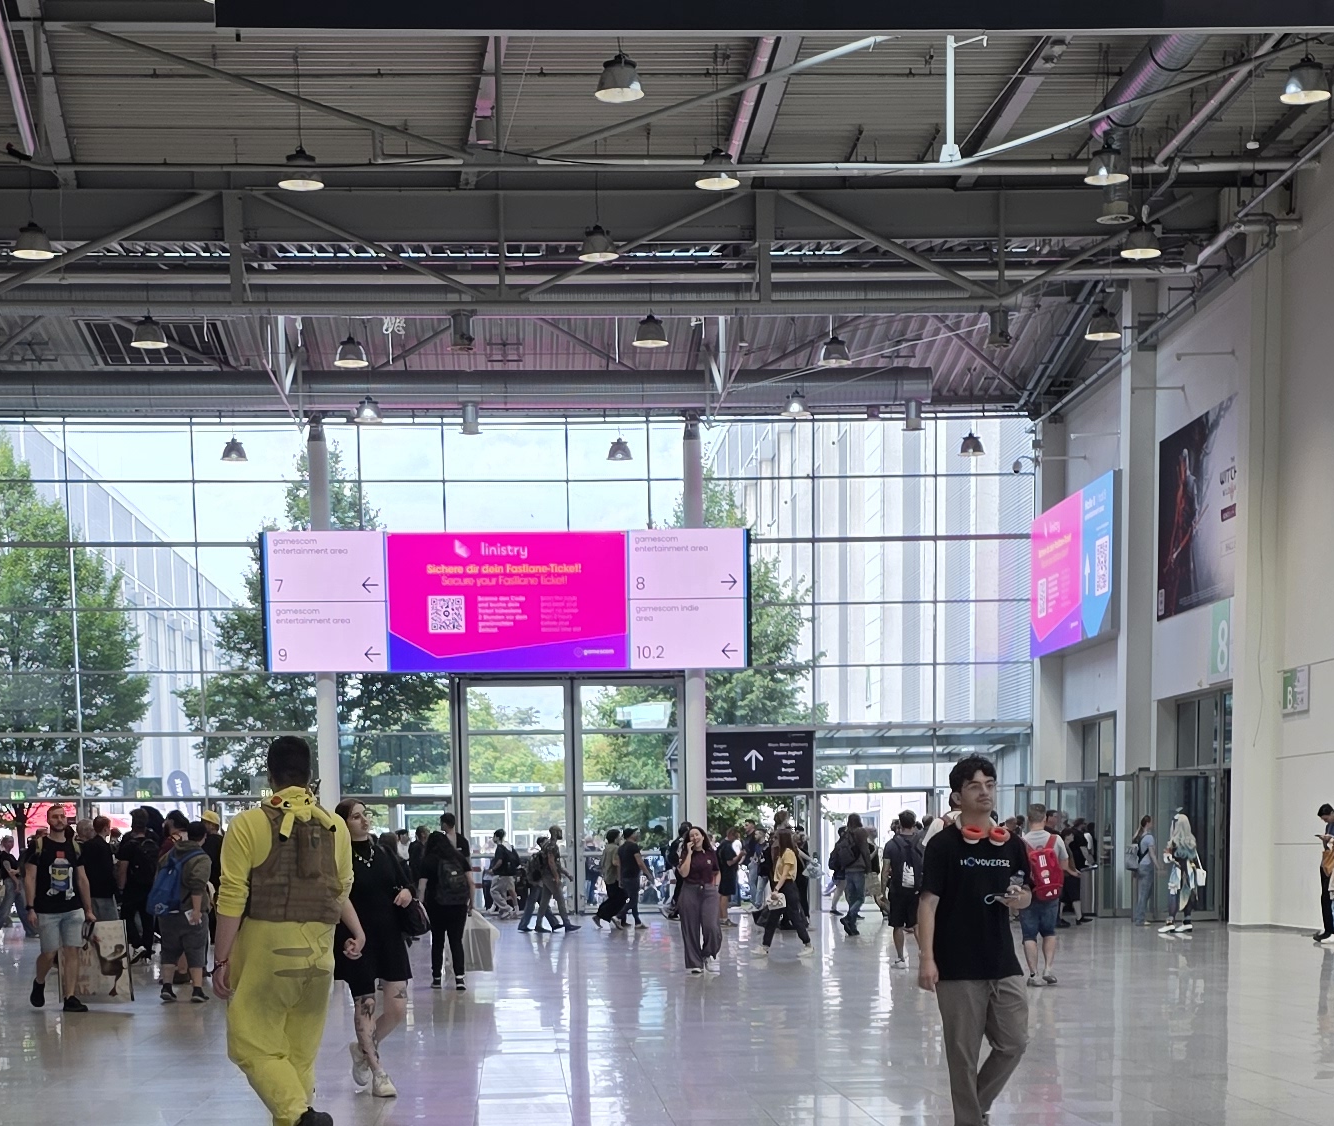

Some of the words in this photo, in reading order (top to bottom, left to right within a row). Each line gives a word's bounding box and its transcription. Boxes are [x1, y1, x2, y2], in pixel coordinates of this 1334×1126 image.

[273, 538, 317, 546] gamescom
[635, 536, 678, 544] gamescom
[480, 542, 528, 559] linistry
[426, 564, 464, 574] Sichere
[467, 564, 479, 574] dir
[481, 564, 503, 574] dein
[274, 579, 283, 592] 7
[477, 577, 496, 587] your
[636, 576, 645, 590] 8
[275, 608, 320, 616] gamescom
[636, 605, 679, 614] gamescom
[1217, 619, 1228, 673] 8
[278, 648, 287, 662] 9
[637, 645, 664, 659] 10.2
